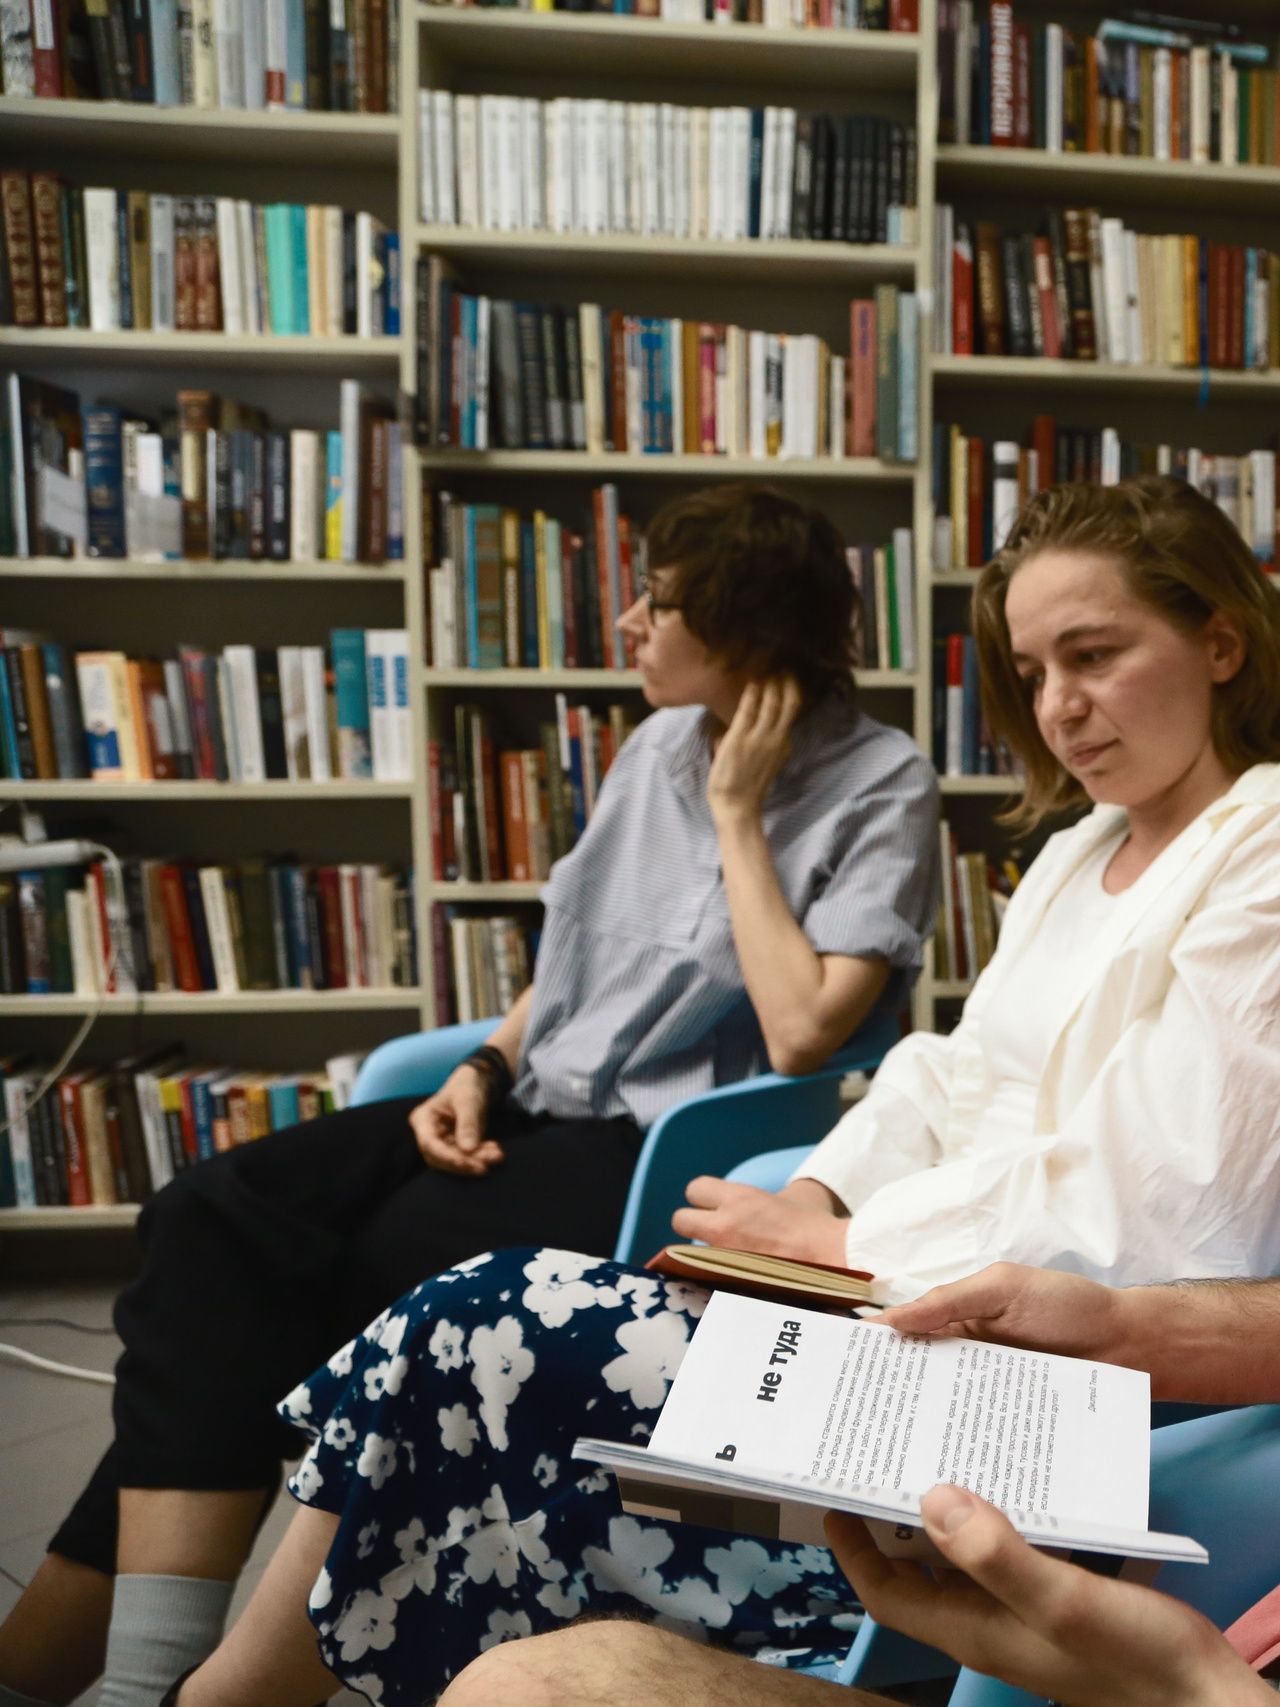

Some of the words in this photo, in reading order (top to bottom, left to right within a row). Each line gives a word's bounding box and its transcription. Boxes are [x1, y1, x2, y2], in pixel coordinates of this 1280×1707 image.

[768, 1320, 802, 1365] туда
[849, 1325, 861, 1338] бренд
[847, 1339, 856, 1351] тогда
[840, 1359, 850, 1375] много
[894, 1355, 902, 1368] если
[1030, 1358, 1038, 1367] Что
[756, 1372, 782, 1402] не
[832, 1376, 844, 1402] слишком
[890, 1370, 899, 1383] себе,
[989, 1368, 1001, 1410] инфраструктура,
[1028, 1369, 1037, 1398] институций.
[830, 1434, 842, 1457] фонда
[837, 1397, 851, 1434] становится
[846, 1376, 858, 1397] важнее
[853, 1346, 866, 1376] содержания,
[862, 1328, 872, 1345] которое
[841, 1428, 857, 1468] социальной
[852, 1396, 865, 1427] функцией
[862, 1359, 875, 1391] ощущением
[870, 1331, 883, 1359] сопричастно-
[884, 1393, 893, 1408] сама
[962, 1378, 974, 1409] экспозиций
[1014, 1388, 1022, 1410] которая
[1038, 1384, 1047, 1413] рассказать
[1051, 1389, 1059, 1413] другого?
[1087, 1386, 1097, 1412] Дмитрий
[851, 1459, 864, 1483] только
[861, 1423, 872, 1448] работы
[868, 1387, 882, 1421] художников
[876, 1356, 889, 1386] формируют
[884, 1347, 892, 1356] это
[881, 1423, 899, 1475] преднамеренно
[894, 1390, 907, 1422] отказаться
[904, 1361, 914, 1382] диалога
[893, 1453, 906, 1490] назначено
[901, 1416, 914, 1452] искусством,
[916, 1354, 928, 1381] принимает
[922, 1346, 930, 1354] это
[937, 1421, 953, 1479] чёрно-серо-белая
[948, 1399, 957, 1418] краска
[956, 1357, 965, 1369] себе
[959, 1410, 968, 1430] смены
[999, 1402, 1008, 1413] Все
[1025, 1399, 1033, 1416] самих
[821, 1403, 837, 1439] становится
[877, 1409, 889, 1435] галерея
[965, 1446, 975, 1469] стенах,
[970, 1403, 982, 1443] маскирующая
[978, 1374, 987, 1394] известь.
[984, 1411, 993, 1432] прочая
[996, 1415, 1006, 1444] симбиоза.
[1008, 1412, 1020, 1452] пространства,
[1023, 1417, 1031, 1433] даже
[1036, 1413, 1045, 1432] смогут
[1049, 1413, 1057, 1432] ничего
[816, 1441, 826, 1459] силы
[869, 1437, 882, 1467] является
[952, 1431, 964, 1468] постоянной
[979, 1441, 990, 1467] провода
[1019, 1439, 1028, 1463] тусовок
[1033, 1433, 1042, 1460] подвалы
[1045, 1433, 1055, 1464] останется
[810, 1460, 820, 1476] этой
[864, 1469, 874, 1484] Чем
[989, 1445, 1001, 1488] поддержания
[1004, 1454, 1013, 1480] каждого
[974, 1471, 985, 1495] озетки,
[1014, 1466, 1025, 1506] экспозиций,
[1028, 1466, 1039, 1499] коридоры
[986, 1490, 995, 1504] для
[1040, 1492, 1048, 1510] если
